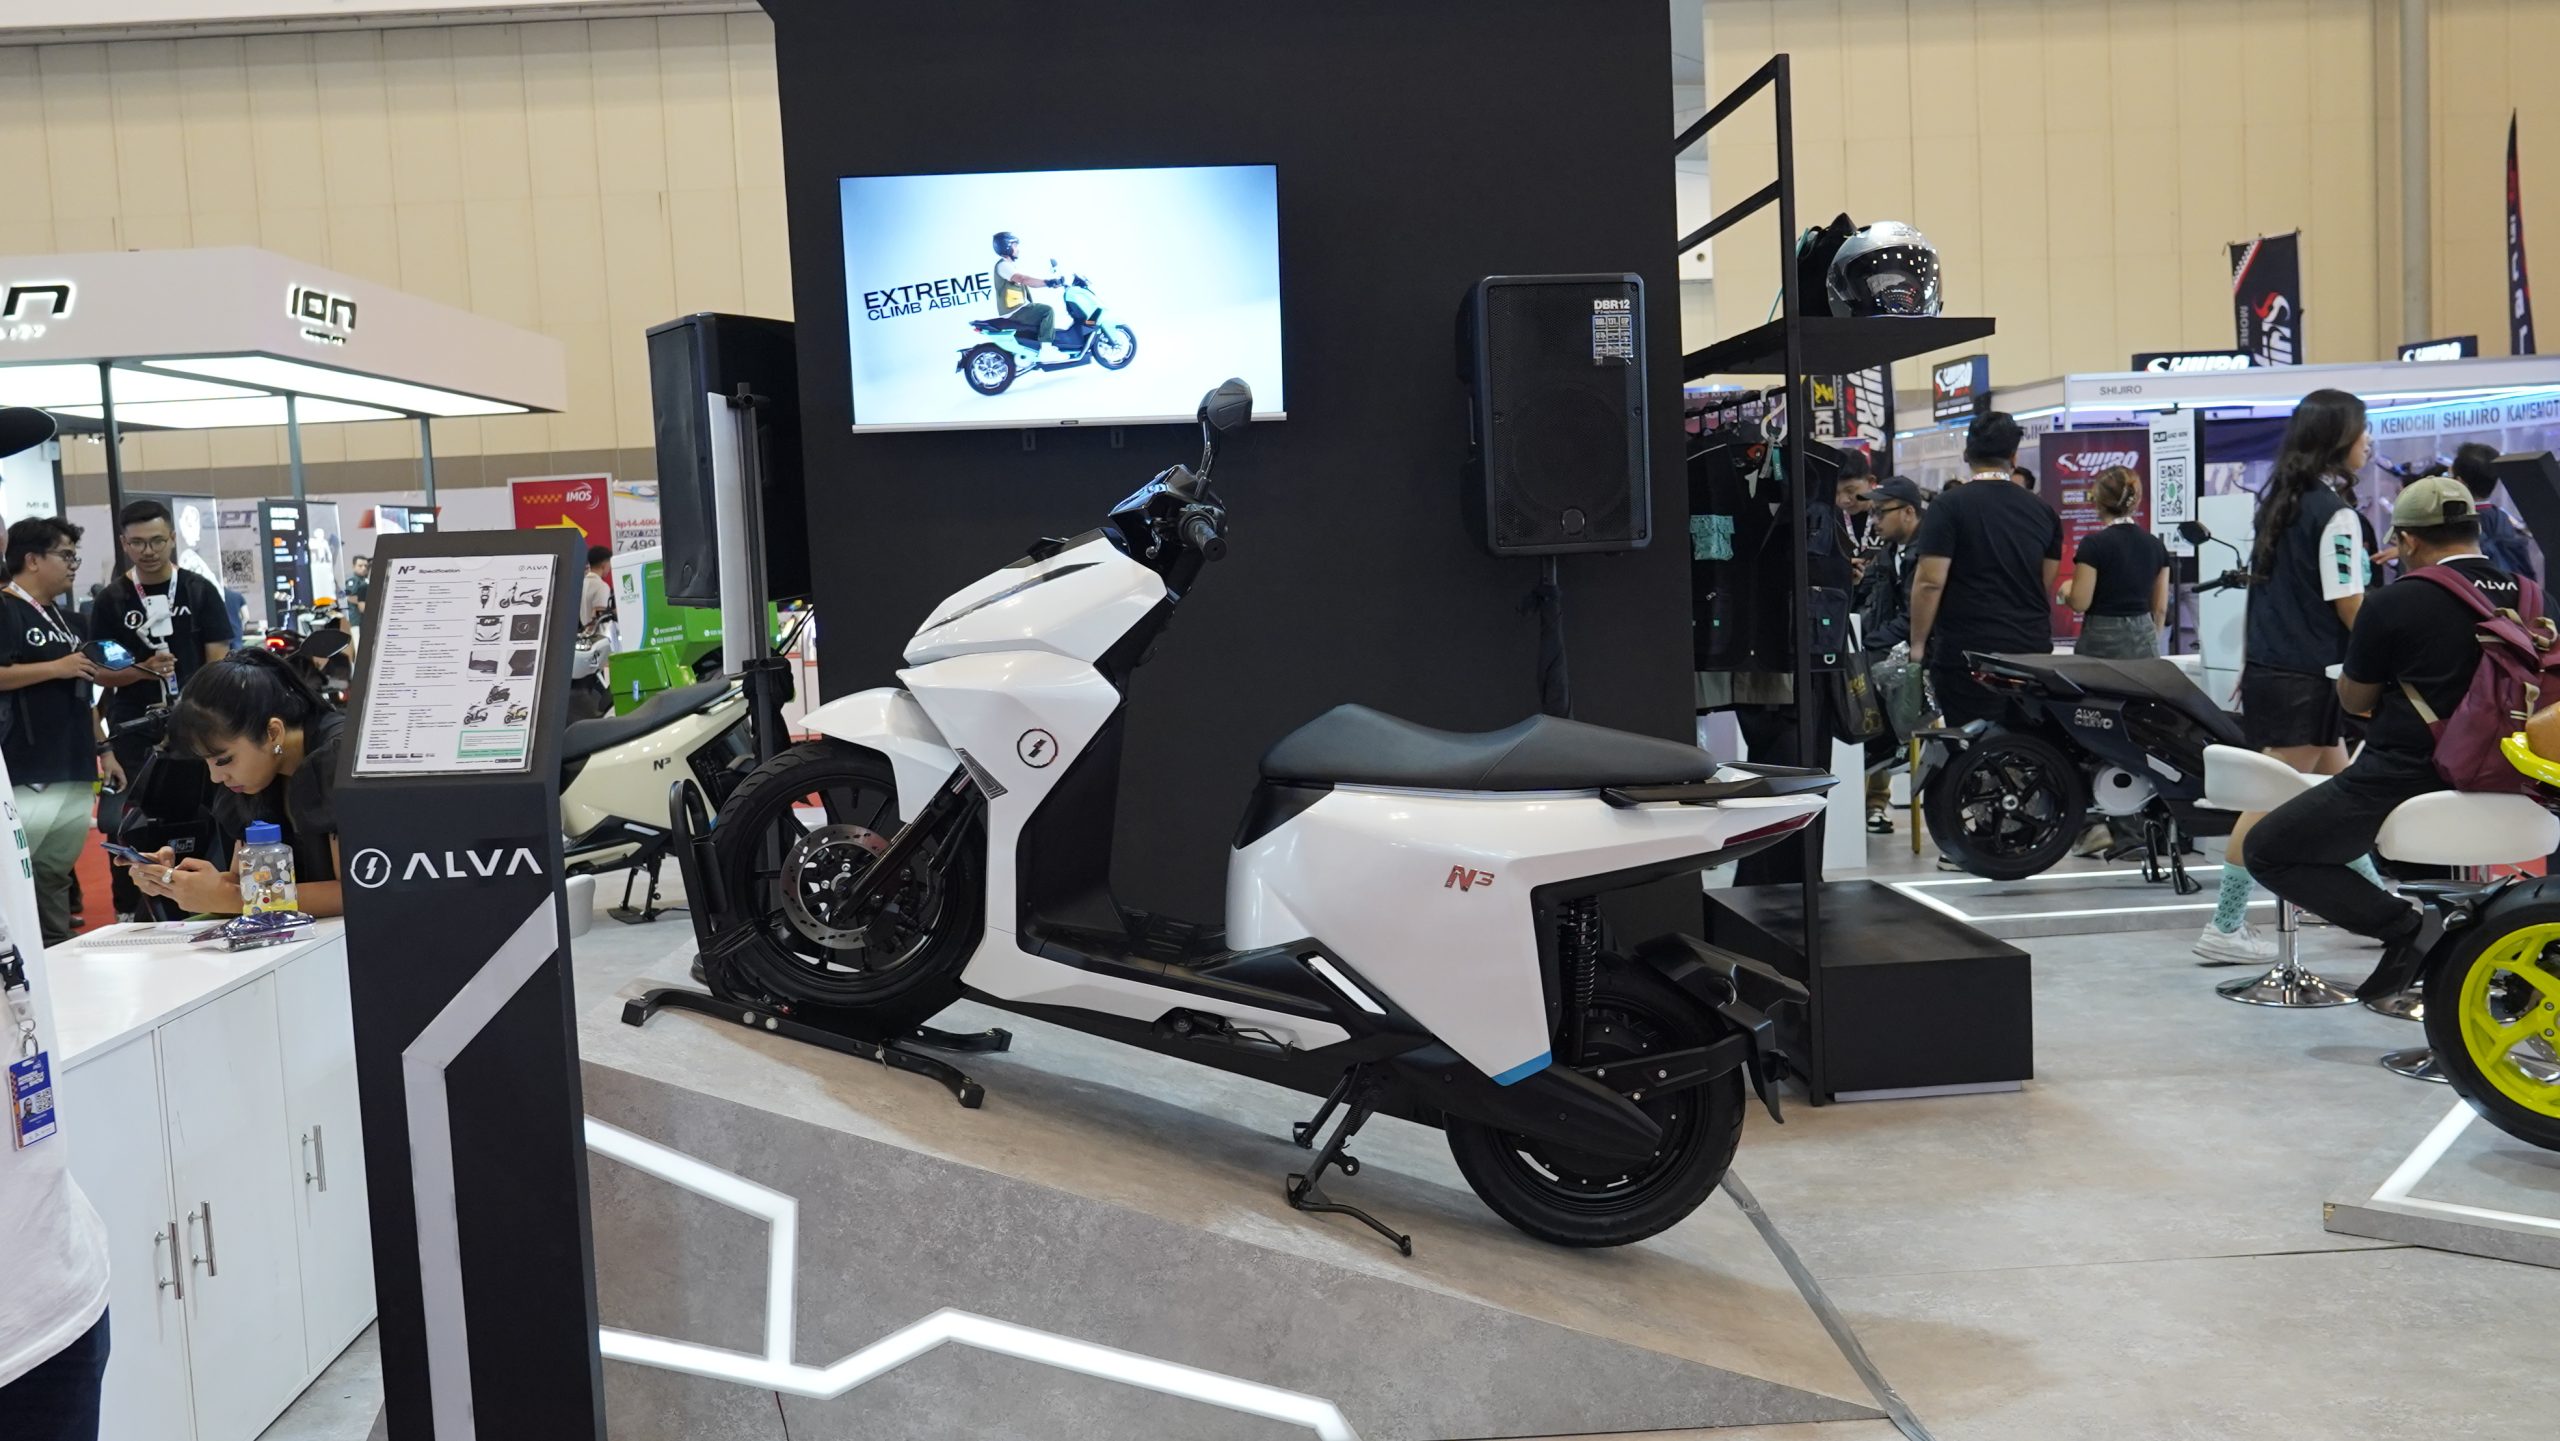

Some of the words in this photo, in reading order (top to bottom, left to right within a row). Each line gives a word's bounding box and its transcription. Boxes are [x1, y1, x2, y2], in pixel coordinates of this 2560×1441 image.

[864, 272, 992, 311] EXTREME
[867, 302, 922, 321] CLIMB
[928, 290, 992, 311] ABILITY
[1594, 299, 1630, 310] DBR12
[2240, 305, 2249, 346] MORE
[2100, 385, 2142, 396] SHIJIRO
[2381, 413, 2436, 434] KENOCHI
[2443, 407, 2500, 428] SHIJIRO
[566, 490, 592, 503] IMOS
[2474, 579, 2518, 591] ALVA
[2075, 708, 2102, 718] ALVA
[402, 847, 543, 880] ALVA
